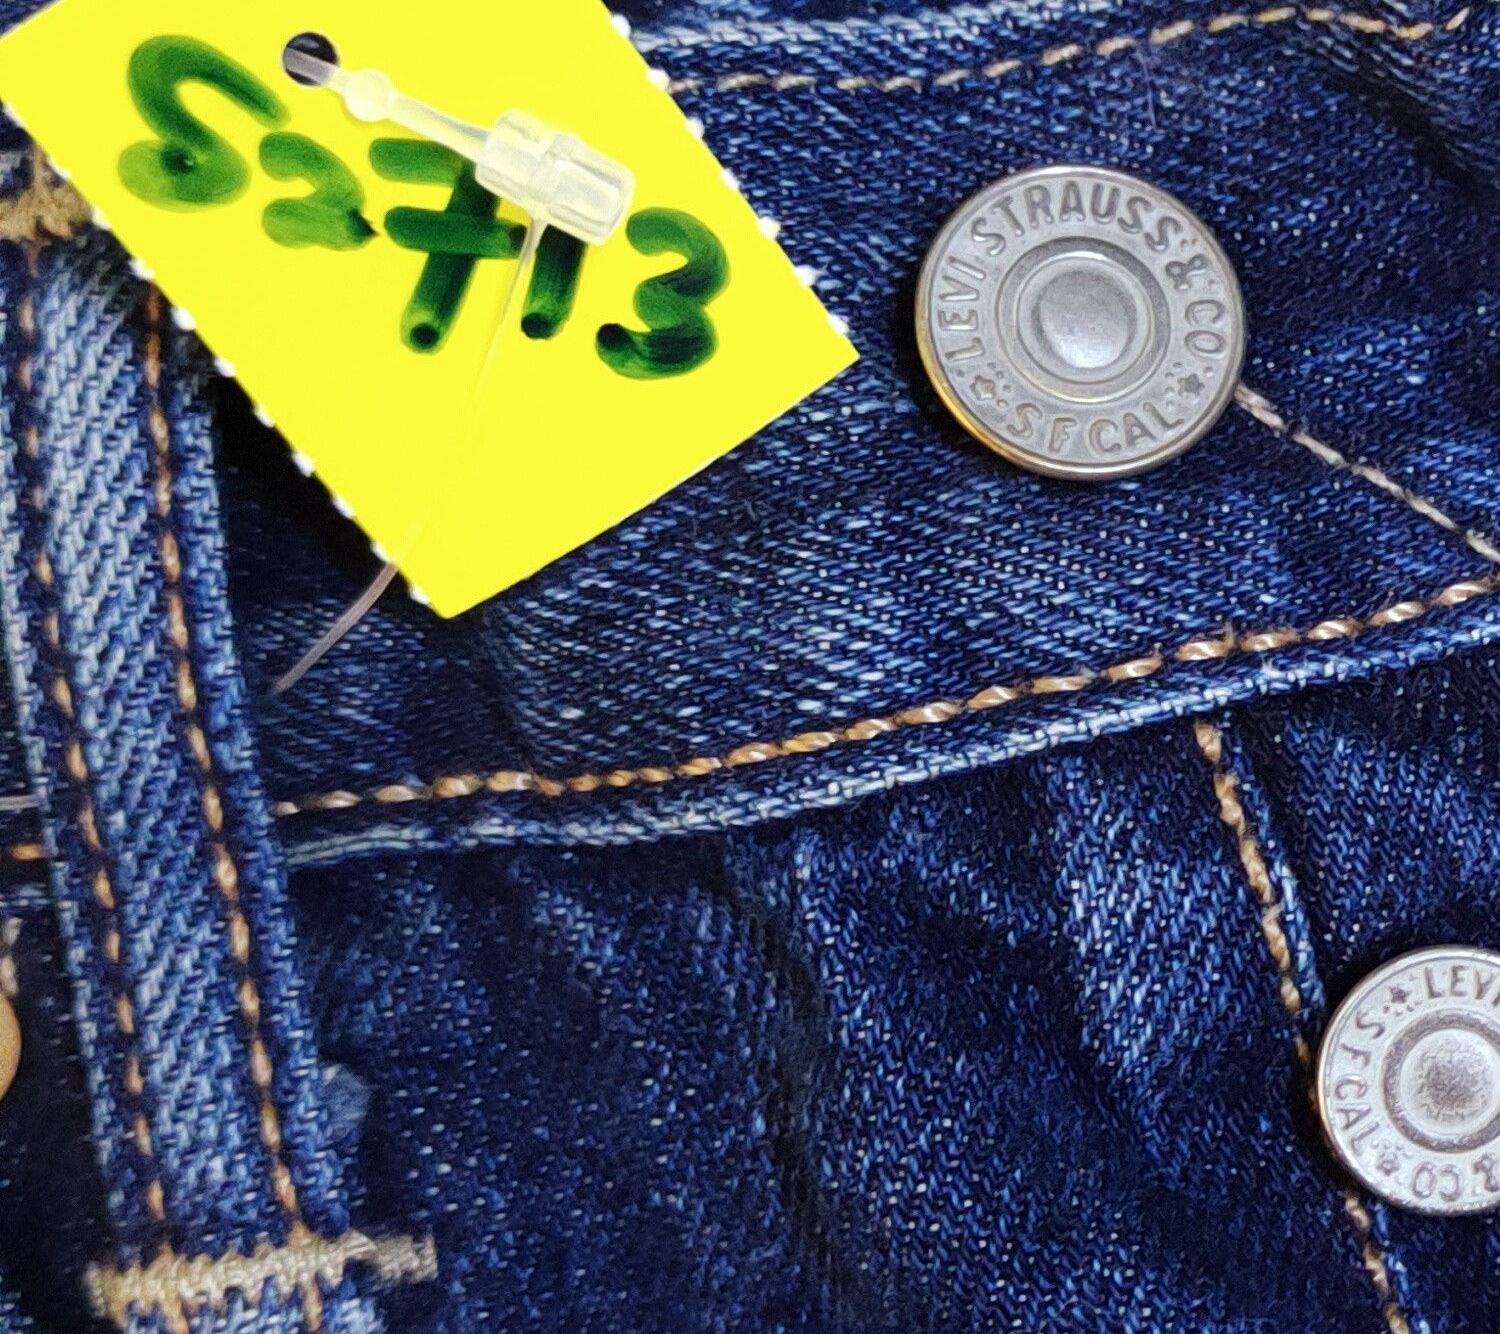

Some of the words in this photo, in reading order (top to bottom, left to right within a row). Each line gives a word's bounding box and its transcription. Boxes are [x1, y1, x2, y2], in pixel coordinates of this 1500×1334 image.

[938, 255, 987, 363] LEVI
[970, 180, 1182, 257] STRAUSS
[1165, 254, 1210, 291] &
